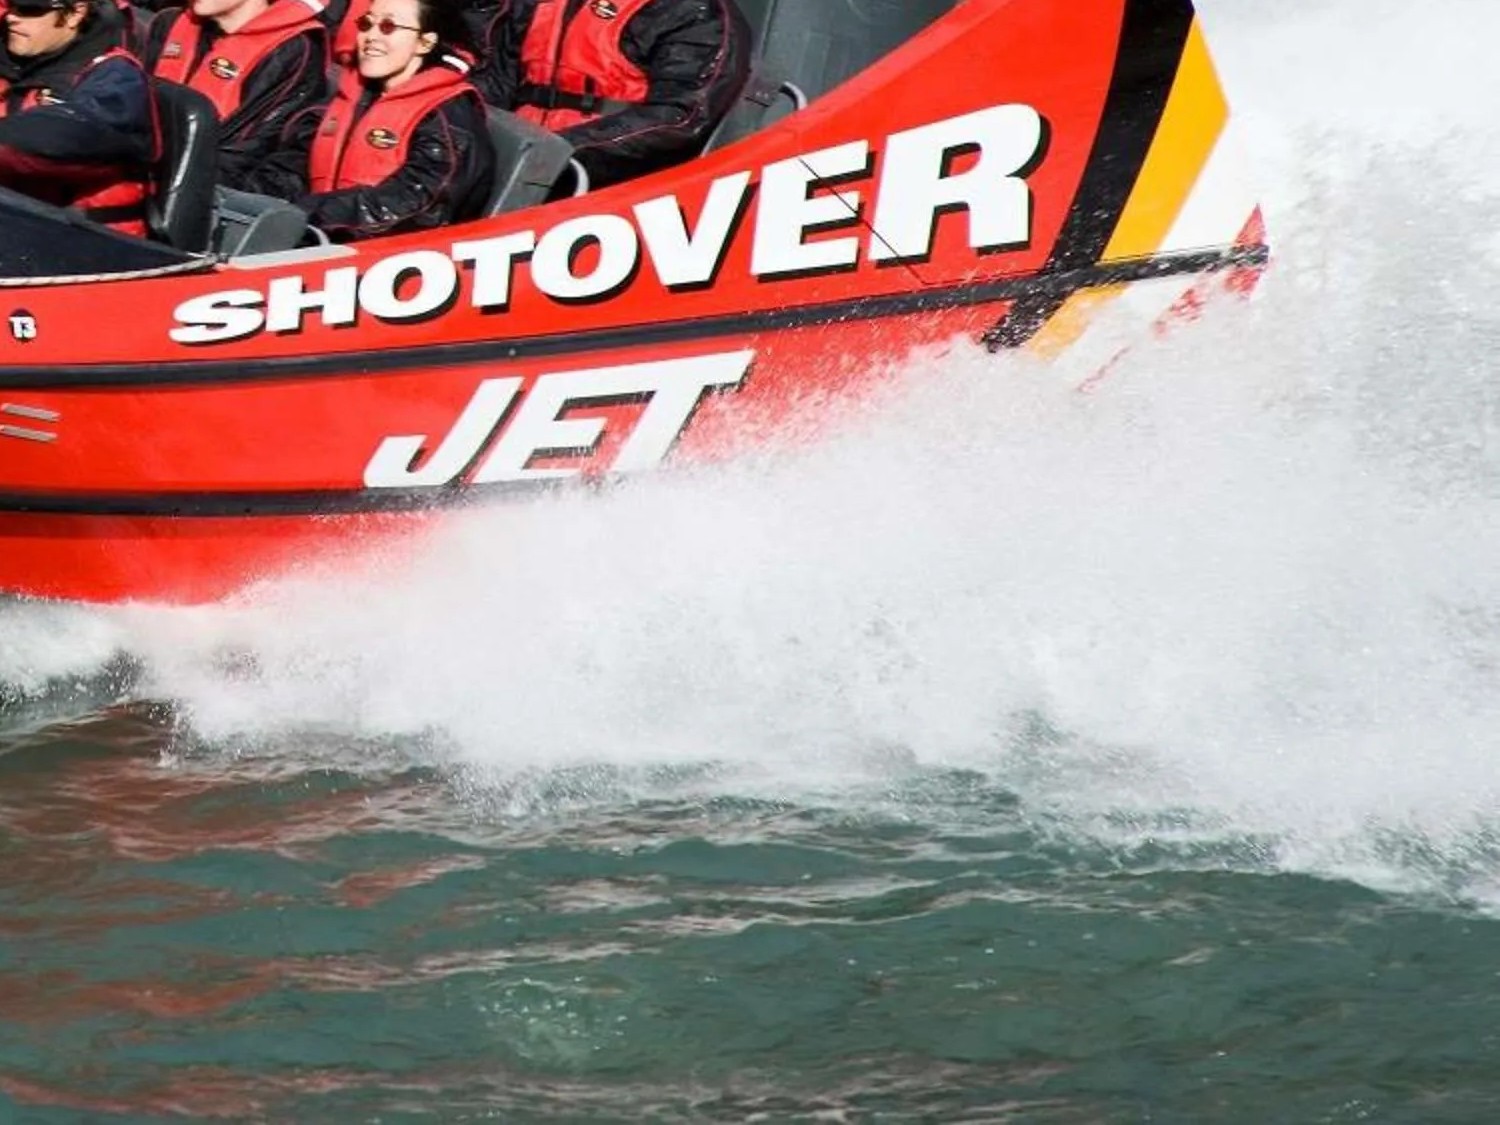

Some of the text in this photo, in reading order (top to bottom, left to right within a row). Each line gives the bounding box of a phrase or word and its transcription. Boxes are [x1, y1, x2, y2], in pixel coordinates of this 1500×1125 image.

[169, 103, 1045, 345] SHOTOVER
[8, 316, 37, 339] 13
[362, 350, 755, 488] JET
